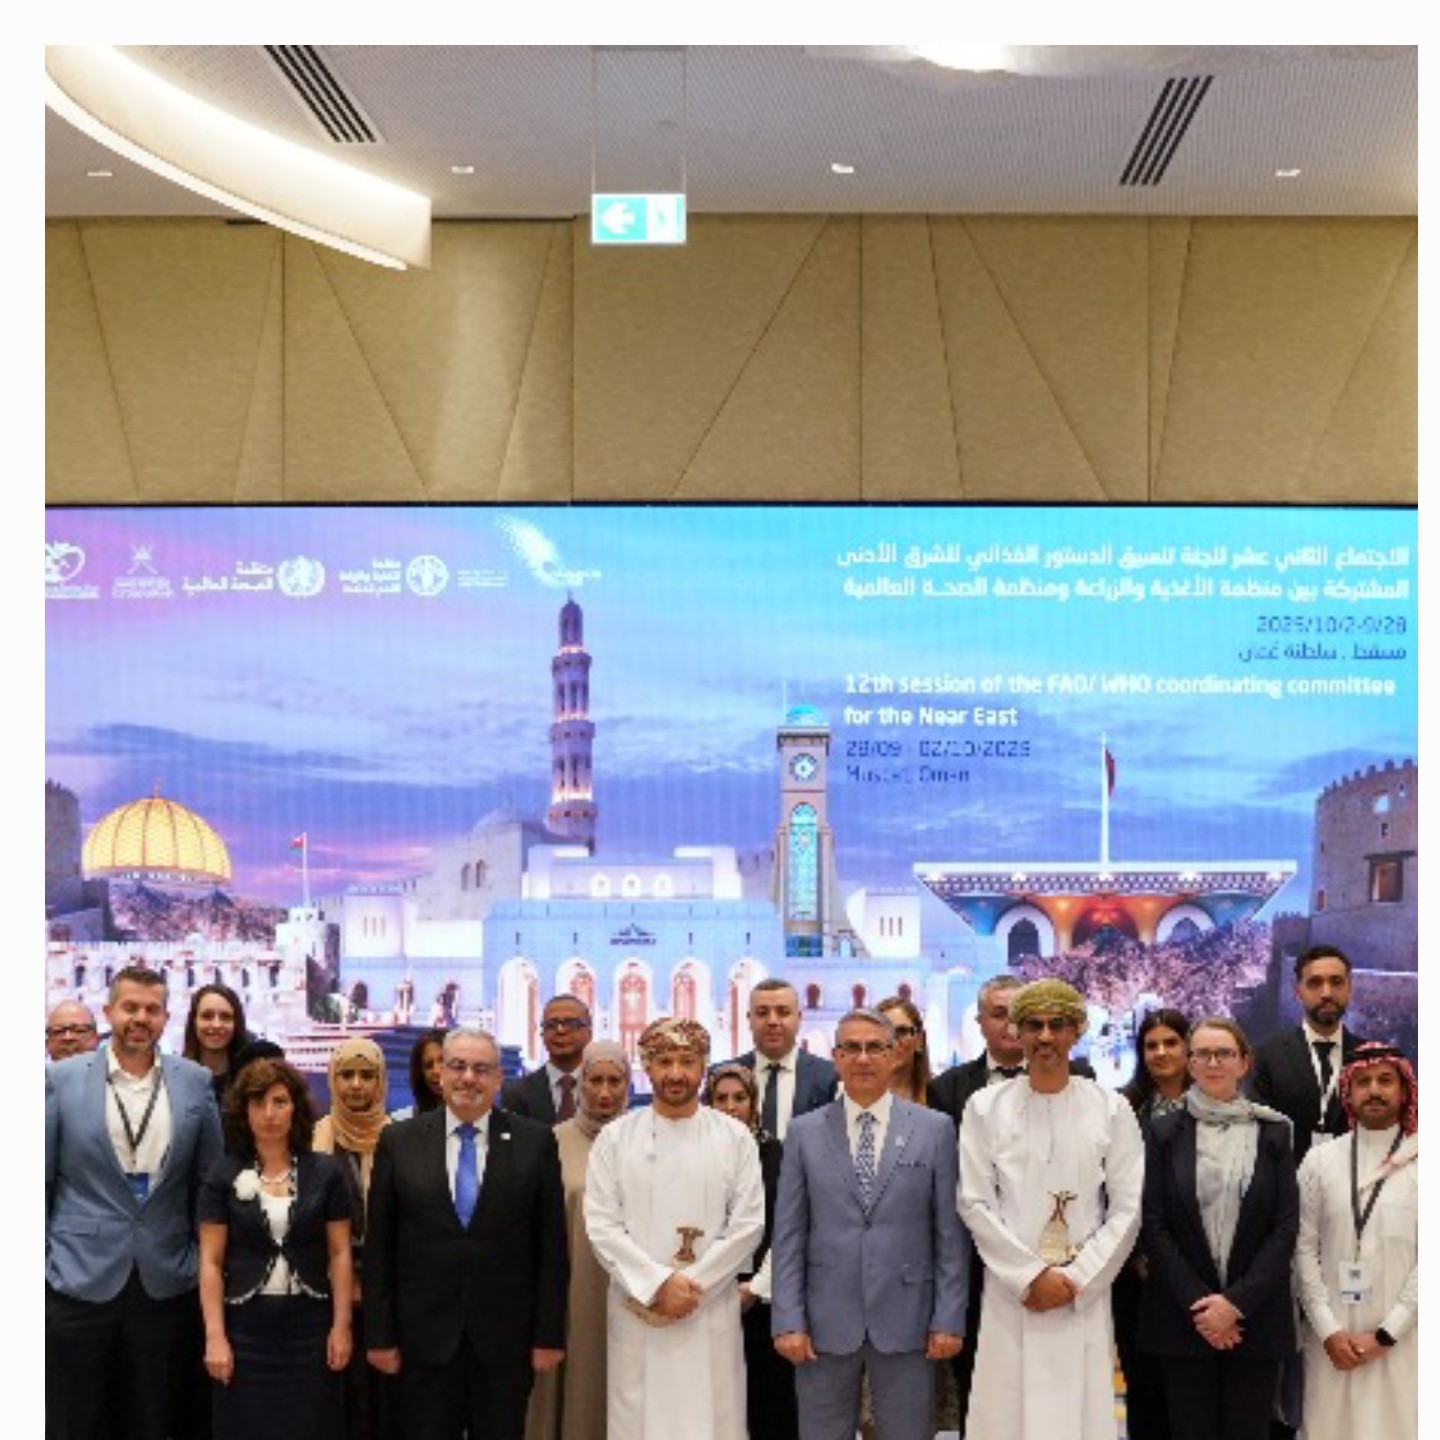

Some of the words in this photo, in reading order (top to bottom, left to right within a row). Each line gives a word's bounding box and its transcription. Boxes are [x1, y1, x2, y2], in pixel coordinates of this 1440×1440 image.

[904, 543, 960, 569] للشرق
[1044, 543, 1112, 568] الدستور
[1180, 545, 1227, 568] للجنة
[1231, 547, 1269, 569] عشر
[1274, 546, 1328, 573] الثاني
[1335, 547, 1410, 570] الاجتماع
[843, 576, 914, 599] العالمية
[992, 578, 1069, 600] ومنظمة
[1074, 577, 1145, 601] والزراعة
[1150, 575, 1213, 601] الأغذية
[1219, 578, 1282, 598] منظمة
[1288, 582, 1318, 602] بين
[1323, 579, 1410, 602] المشتركة
[844, 674, 894, 694] 12th
[900, 674, 976, 694] session
[980, 674, 1003, 694] of
[1006, 674, 1043, 694] the
[1100, 674, 1151, 695] WHO
[1156, 673, 1283, 699] coordinating
[1286, 674, 1396, 695] committee
[843, 706, 879, 727] for
[879, 706, 914, 727] the
[919, 706, 969, 727] Near
[973, 706, 1019, 727] East
